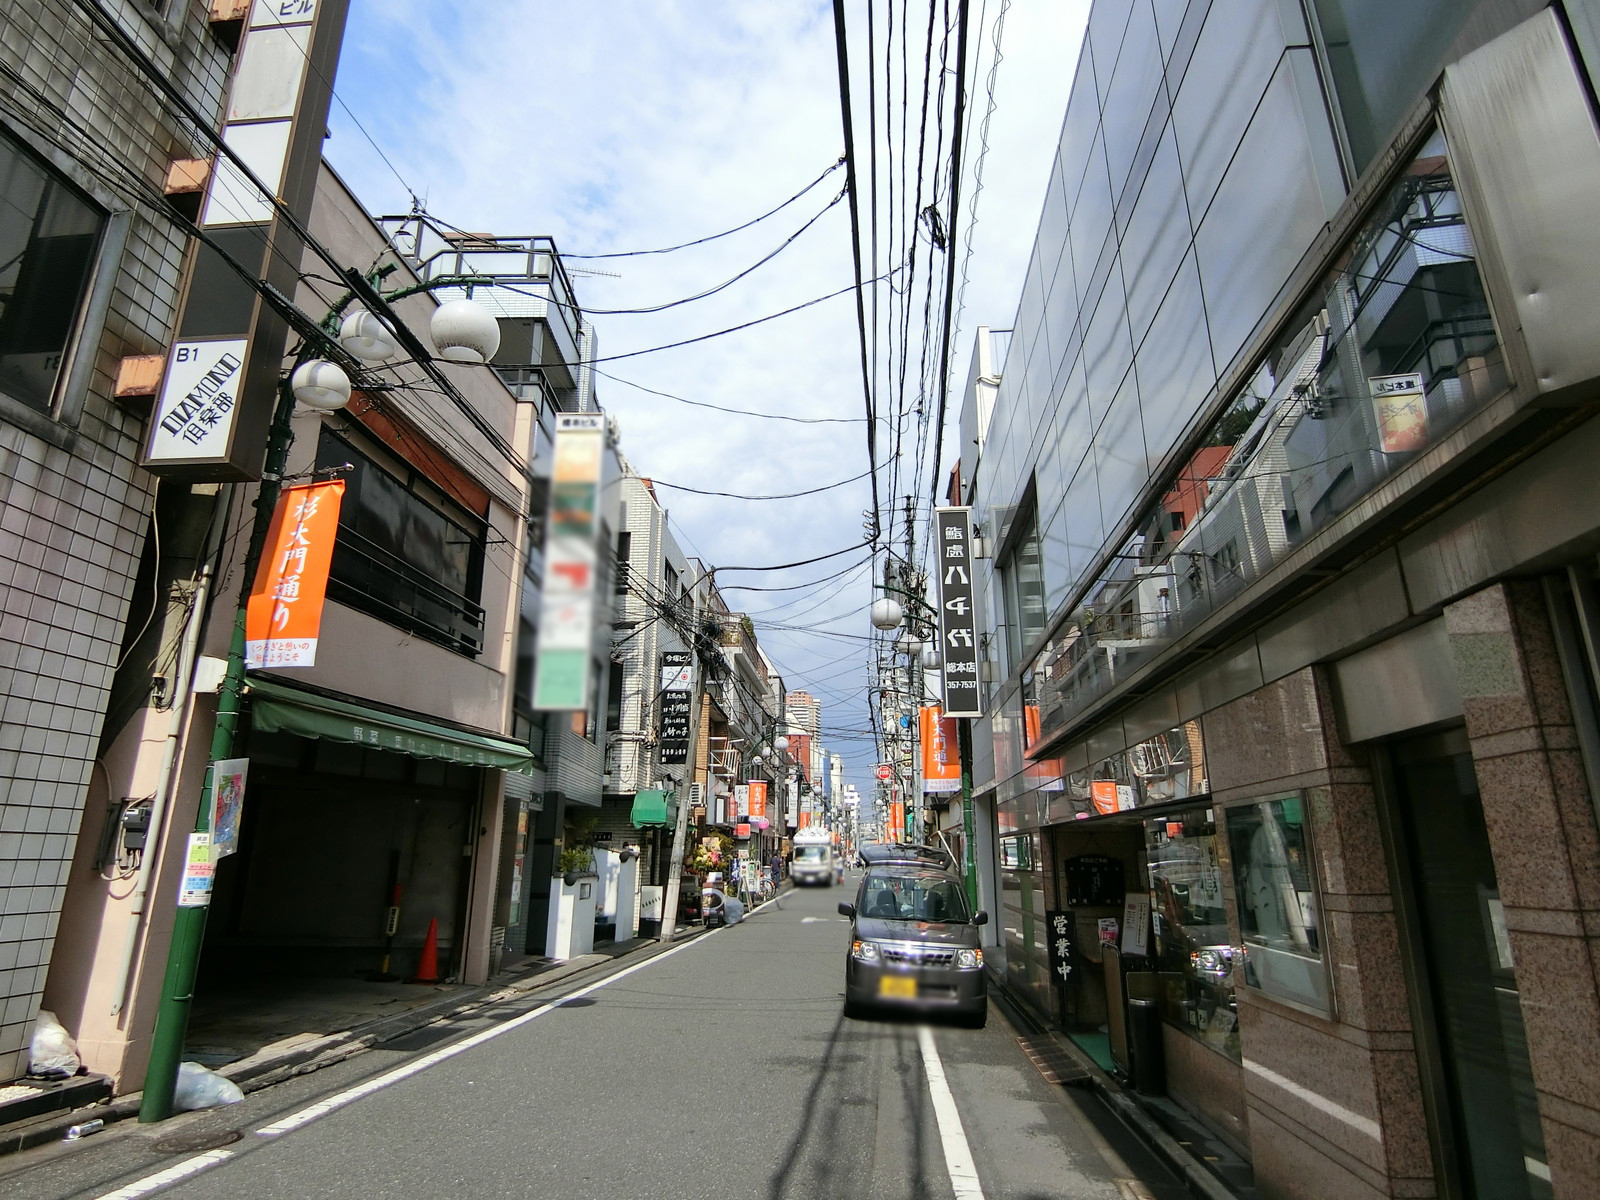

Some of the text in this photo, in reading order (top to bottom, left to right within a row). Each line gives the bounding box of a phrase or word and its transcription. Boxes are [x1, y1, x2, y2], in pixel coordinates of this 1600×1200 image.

[279, 0, 313, 16] ビル
[176, 347, 199, 363] B1
[160, 352, 242, 438] DIAMOND
[182, 391, 235, 446] 倶楽部
[272, 495, 321, 632] 杉大門通り
[946, 661, 976, 673] 総本店
[947, 681, 977, 689] 357-7537
[932, 711, 948, 777] 杉大門通り
[1053, 914, 1072, 982] 営業中
